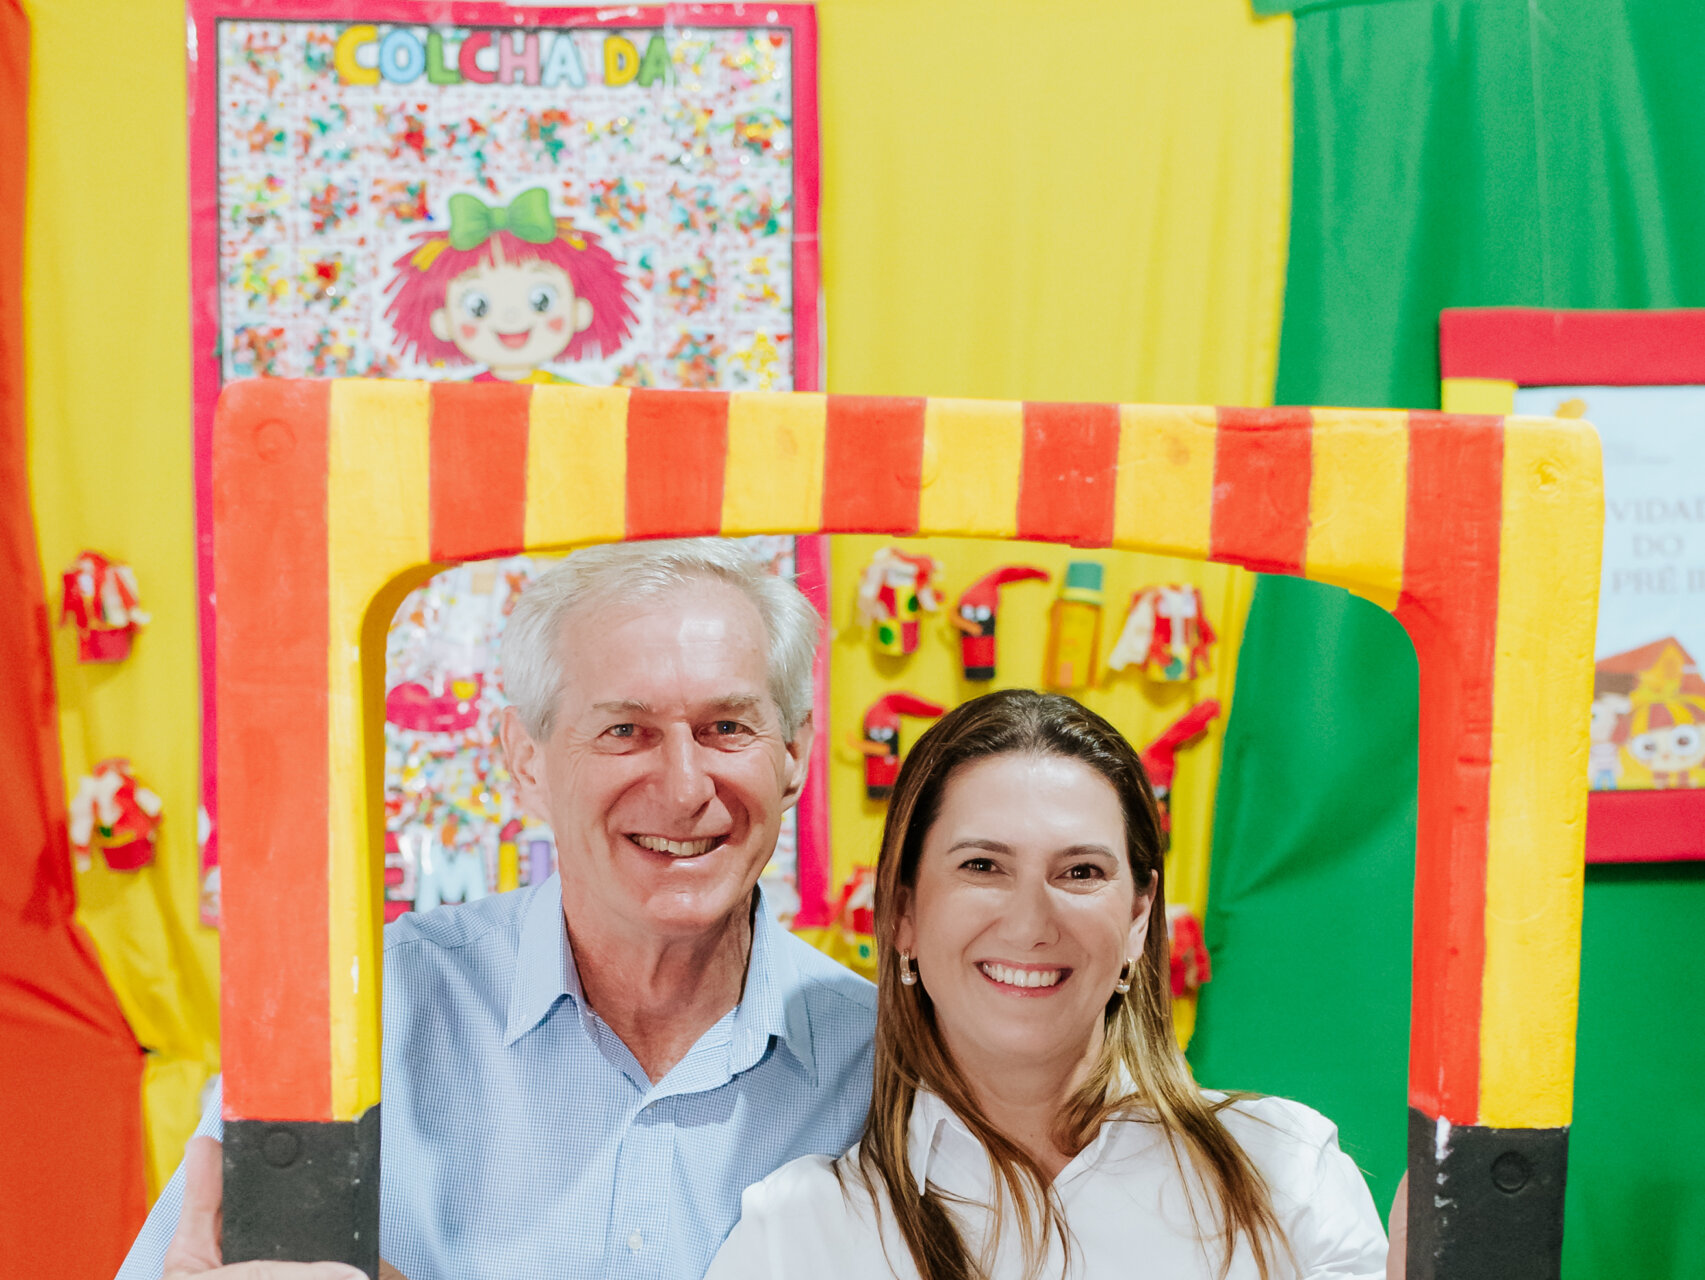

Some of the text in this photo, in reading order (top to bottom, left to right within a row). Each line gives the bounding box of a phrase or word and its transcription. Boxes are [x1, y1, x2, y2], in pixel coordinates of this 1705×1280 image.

[334, 24, 675, 88] COLCHA DA
[1632, 533, 1684, 559] DO
